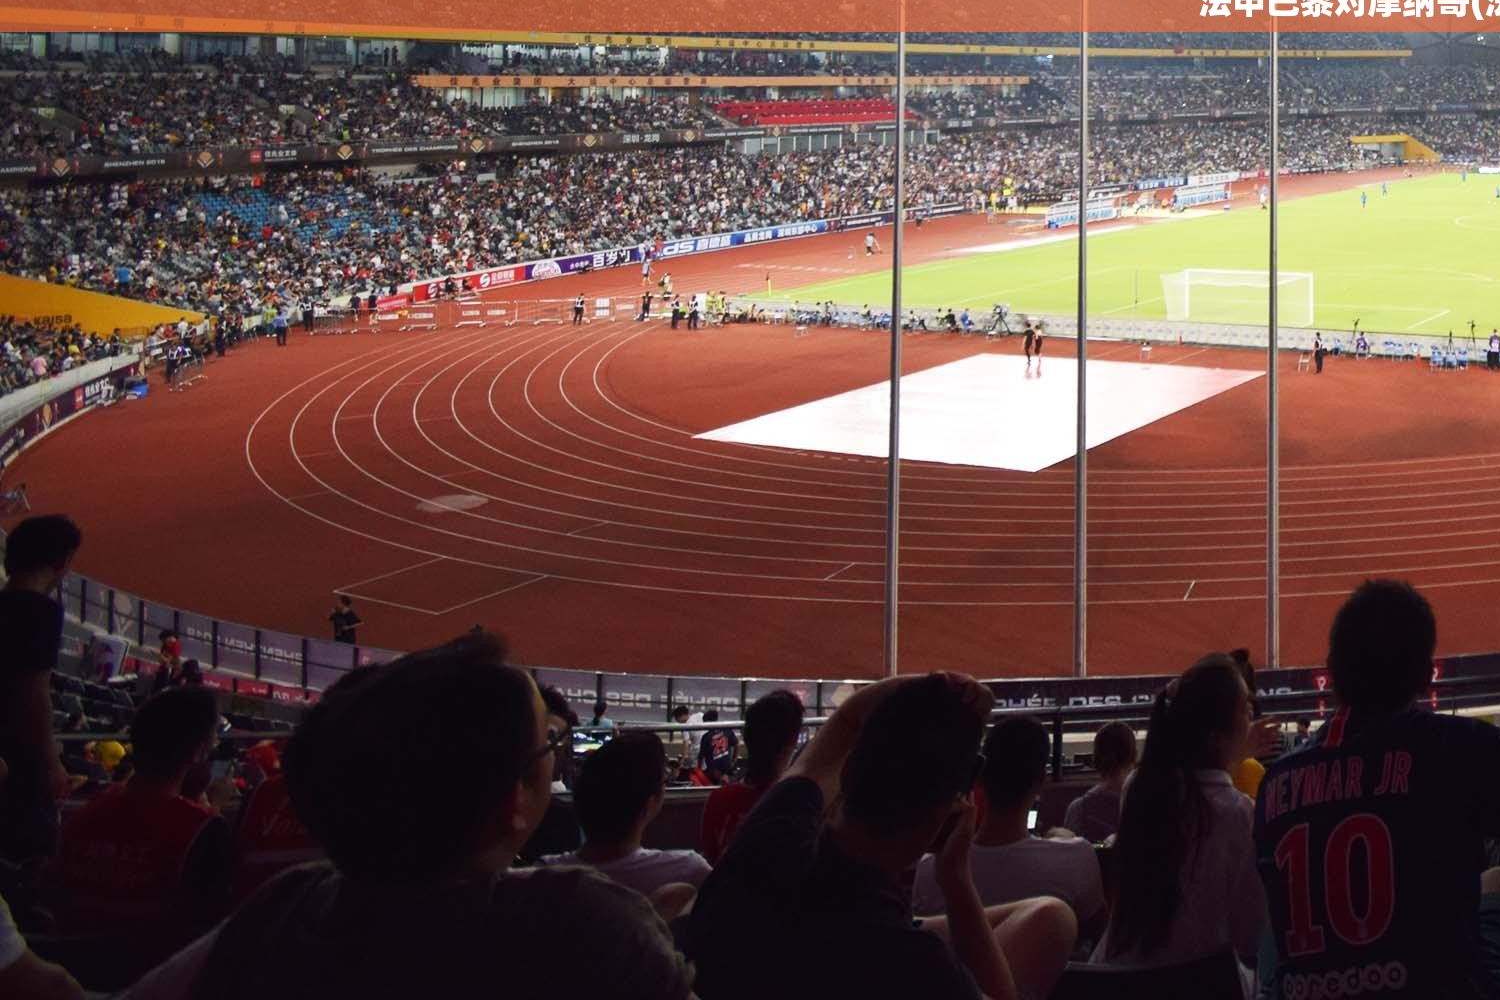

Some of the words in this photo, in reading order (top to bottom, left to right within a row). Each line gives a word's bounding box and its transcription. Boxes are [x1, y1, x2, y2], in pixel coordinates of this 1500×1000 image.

[1264, 756, 1364, 822] NEYMAR
[1374, 750, 1414, 795] JR
[1273, 812, 1396, 958] 10
